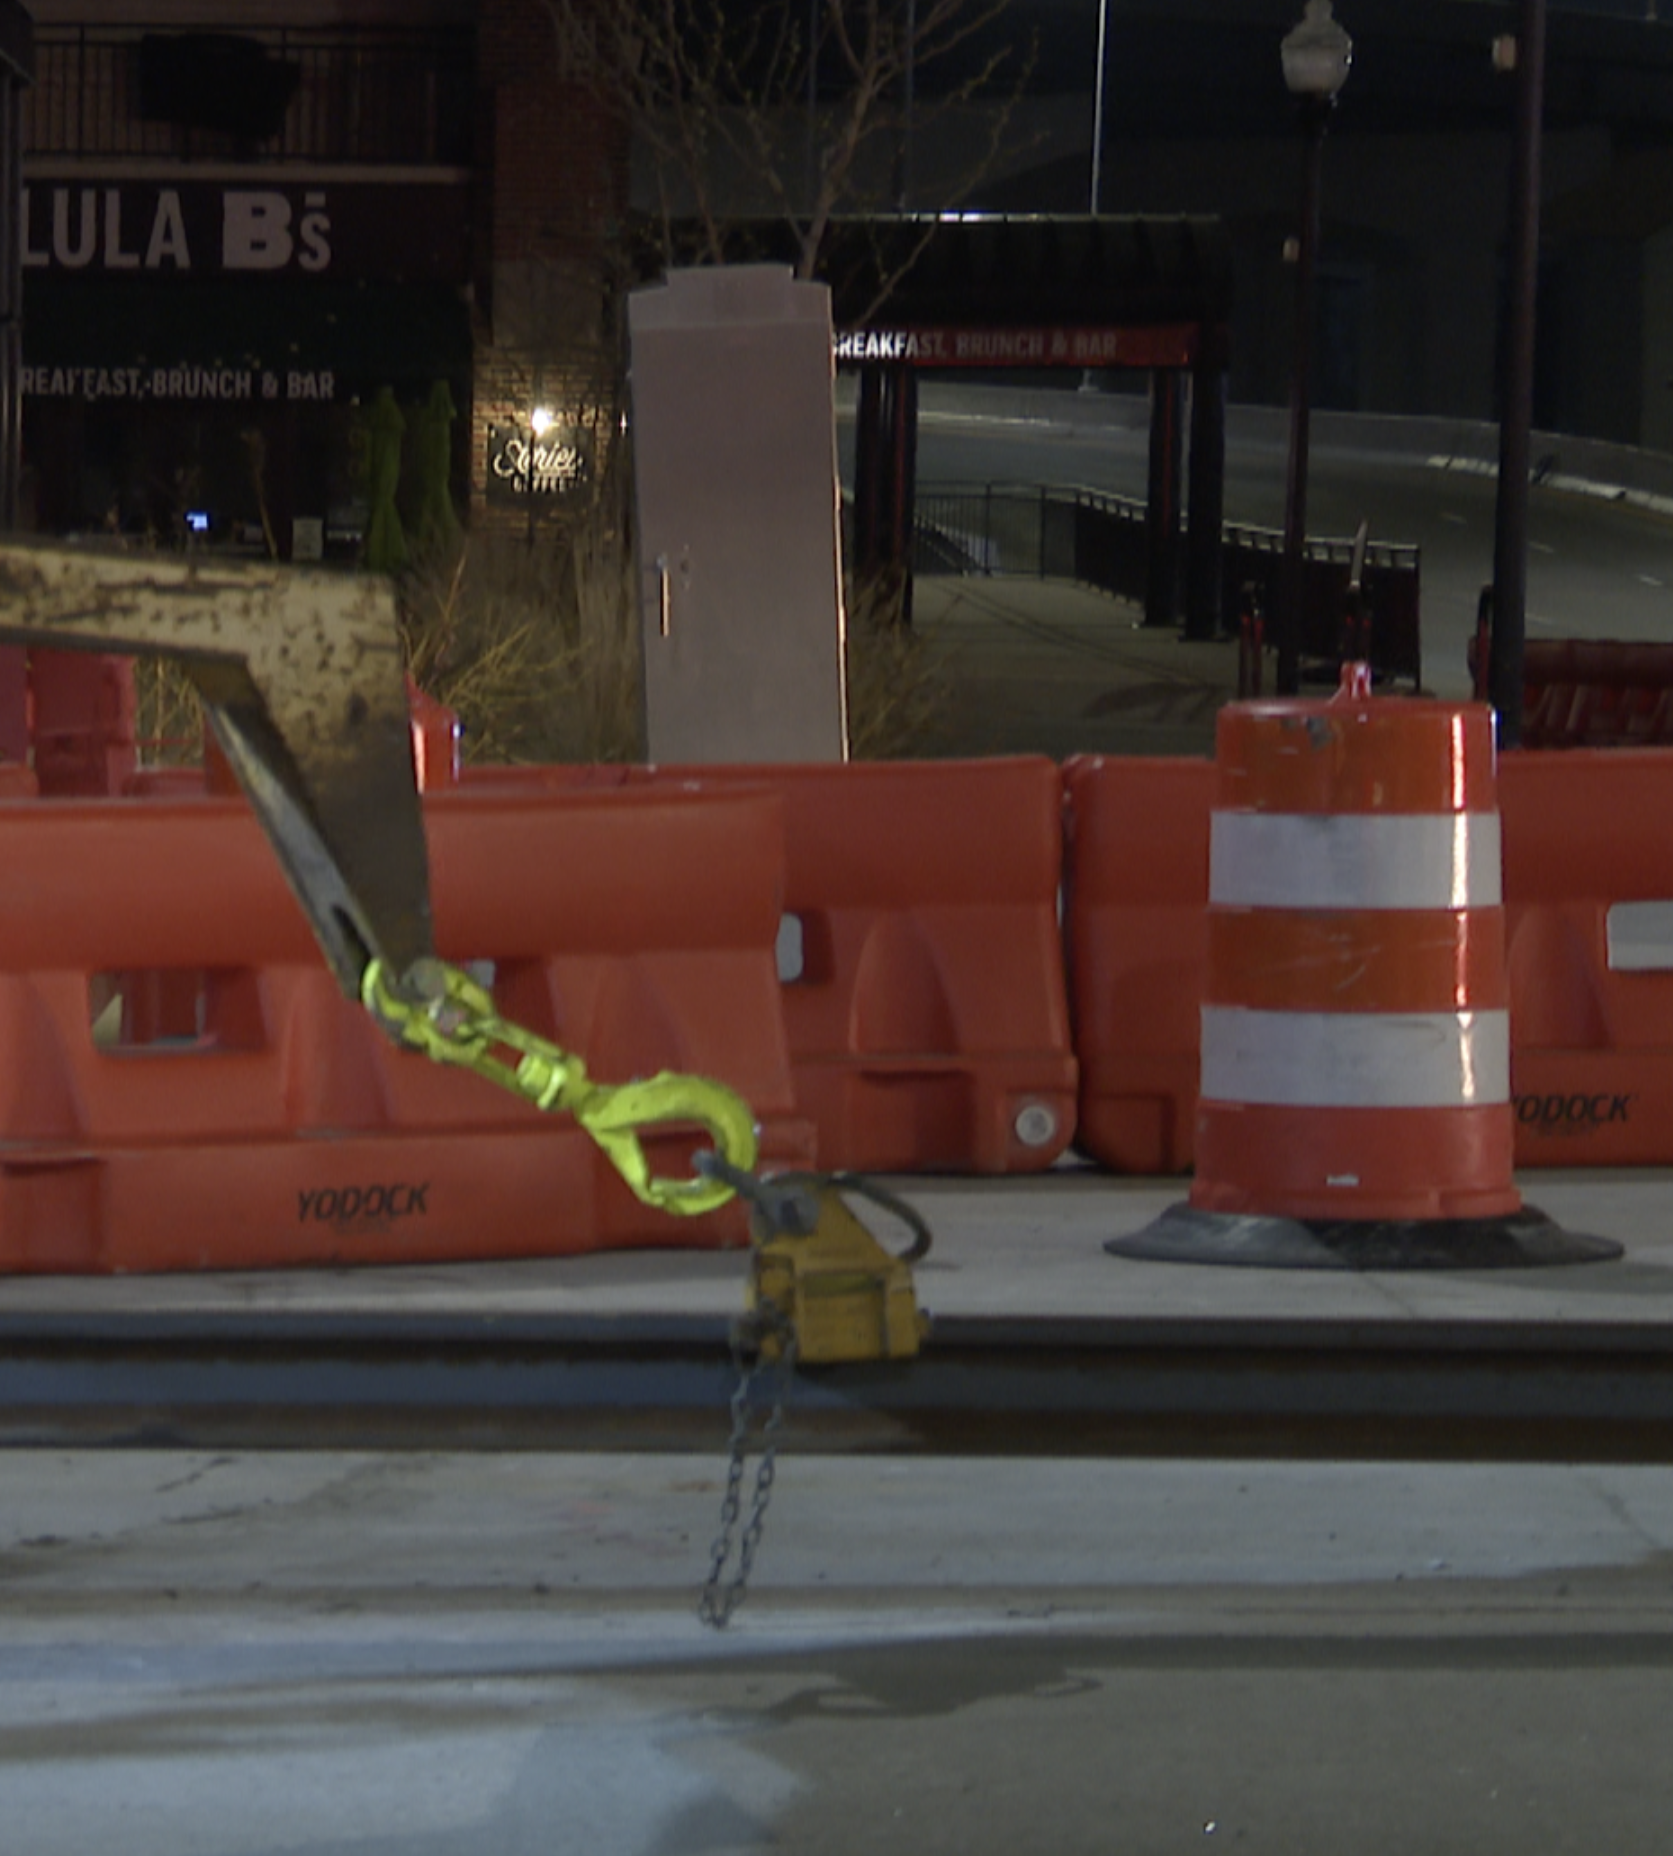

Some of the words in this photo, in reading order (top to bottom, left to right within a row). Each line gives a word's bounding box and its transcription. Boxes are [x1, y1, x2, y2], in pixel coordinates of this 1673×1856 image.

[19, 186, 192, 270] LULA
[955, 331, 1044, 359] BRUNCH
[1051, 332, 1068, 358] &
[1073, 331, 1118, 359] BAR
[19, 366, 147, 400] REAKFAST,
[151, 367, 253, 399] BRUNCH
[261, 370, 279, 399] &
[286, 370, 336, 400] BAR
[296, 1180, 431, 1223] YODOCK
